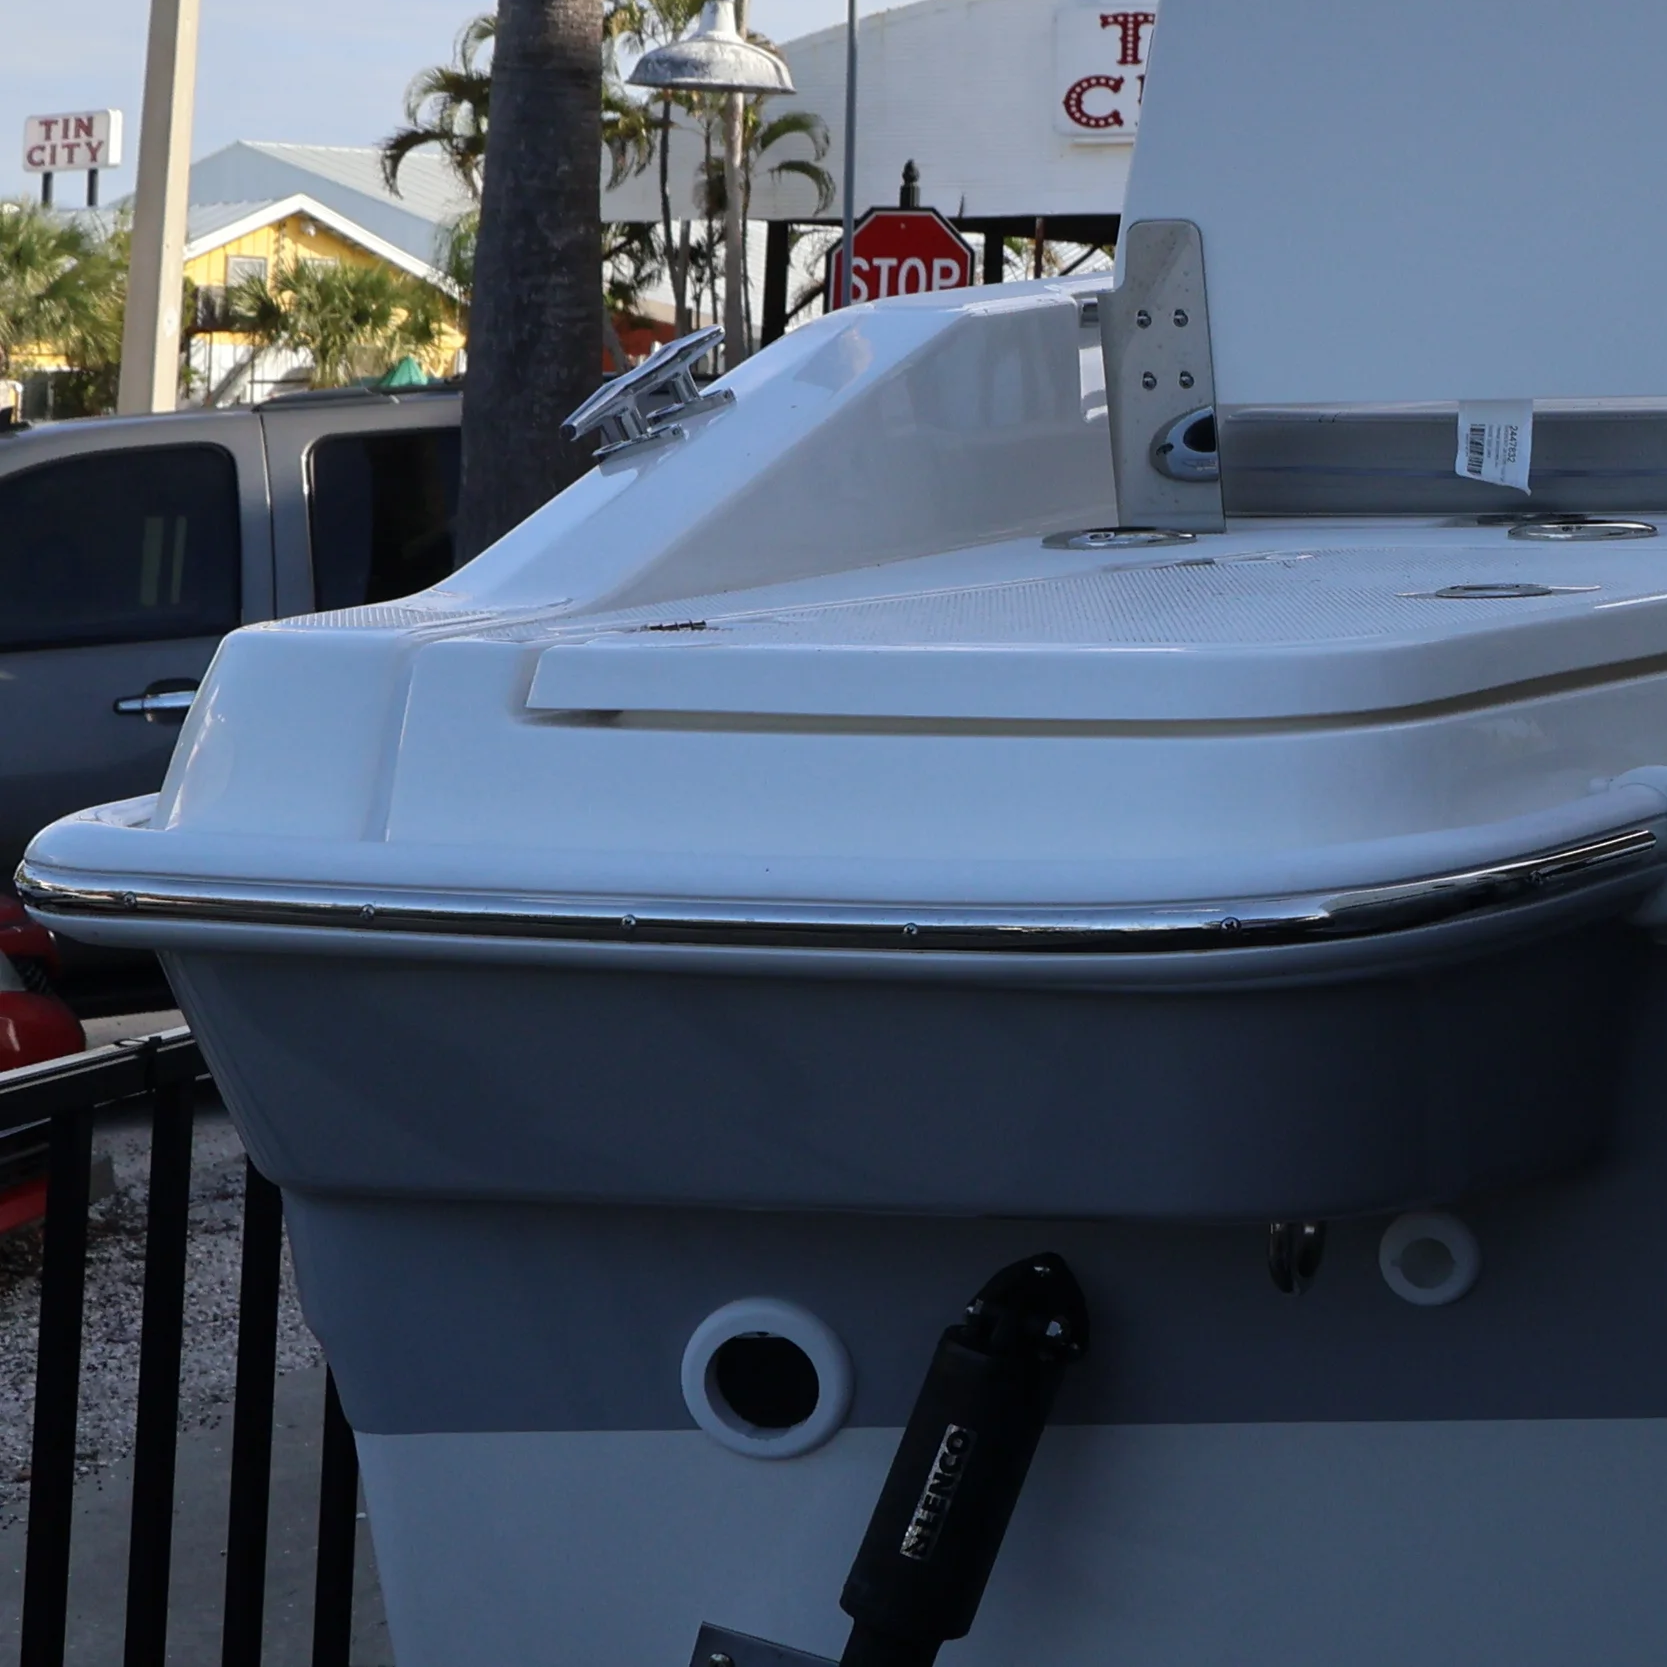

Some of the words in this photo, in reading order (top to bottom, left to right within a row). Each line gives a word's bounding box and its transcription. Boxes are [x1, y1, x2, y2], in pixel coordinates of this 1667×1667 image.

[1100, 11, 1156, 66] T
[1062, 73, 1147, 129] C
[26, 140, 104, 167] CITY
[39, 116, 94, 141] TIN
[851, 257, 961, 304] STOP
[914, 1430, 971, 1530] LENCO
